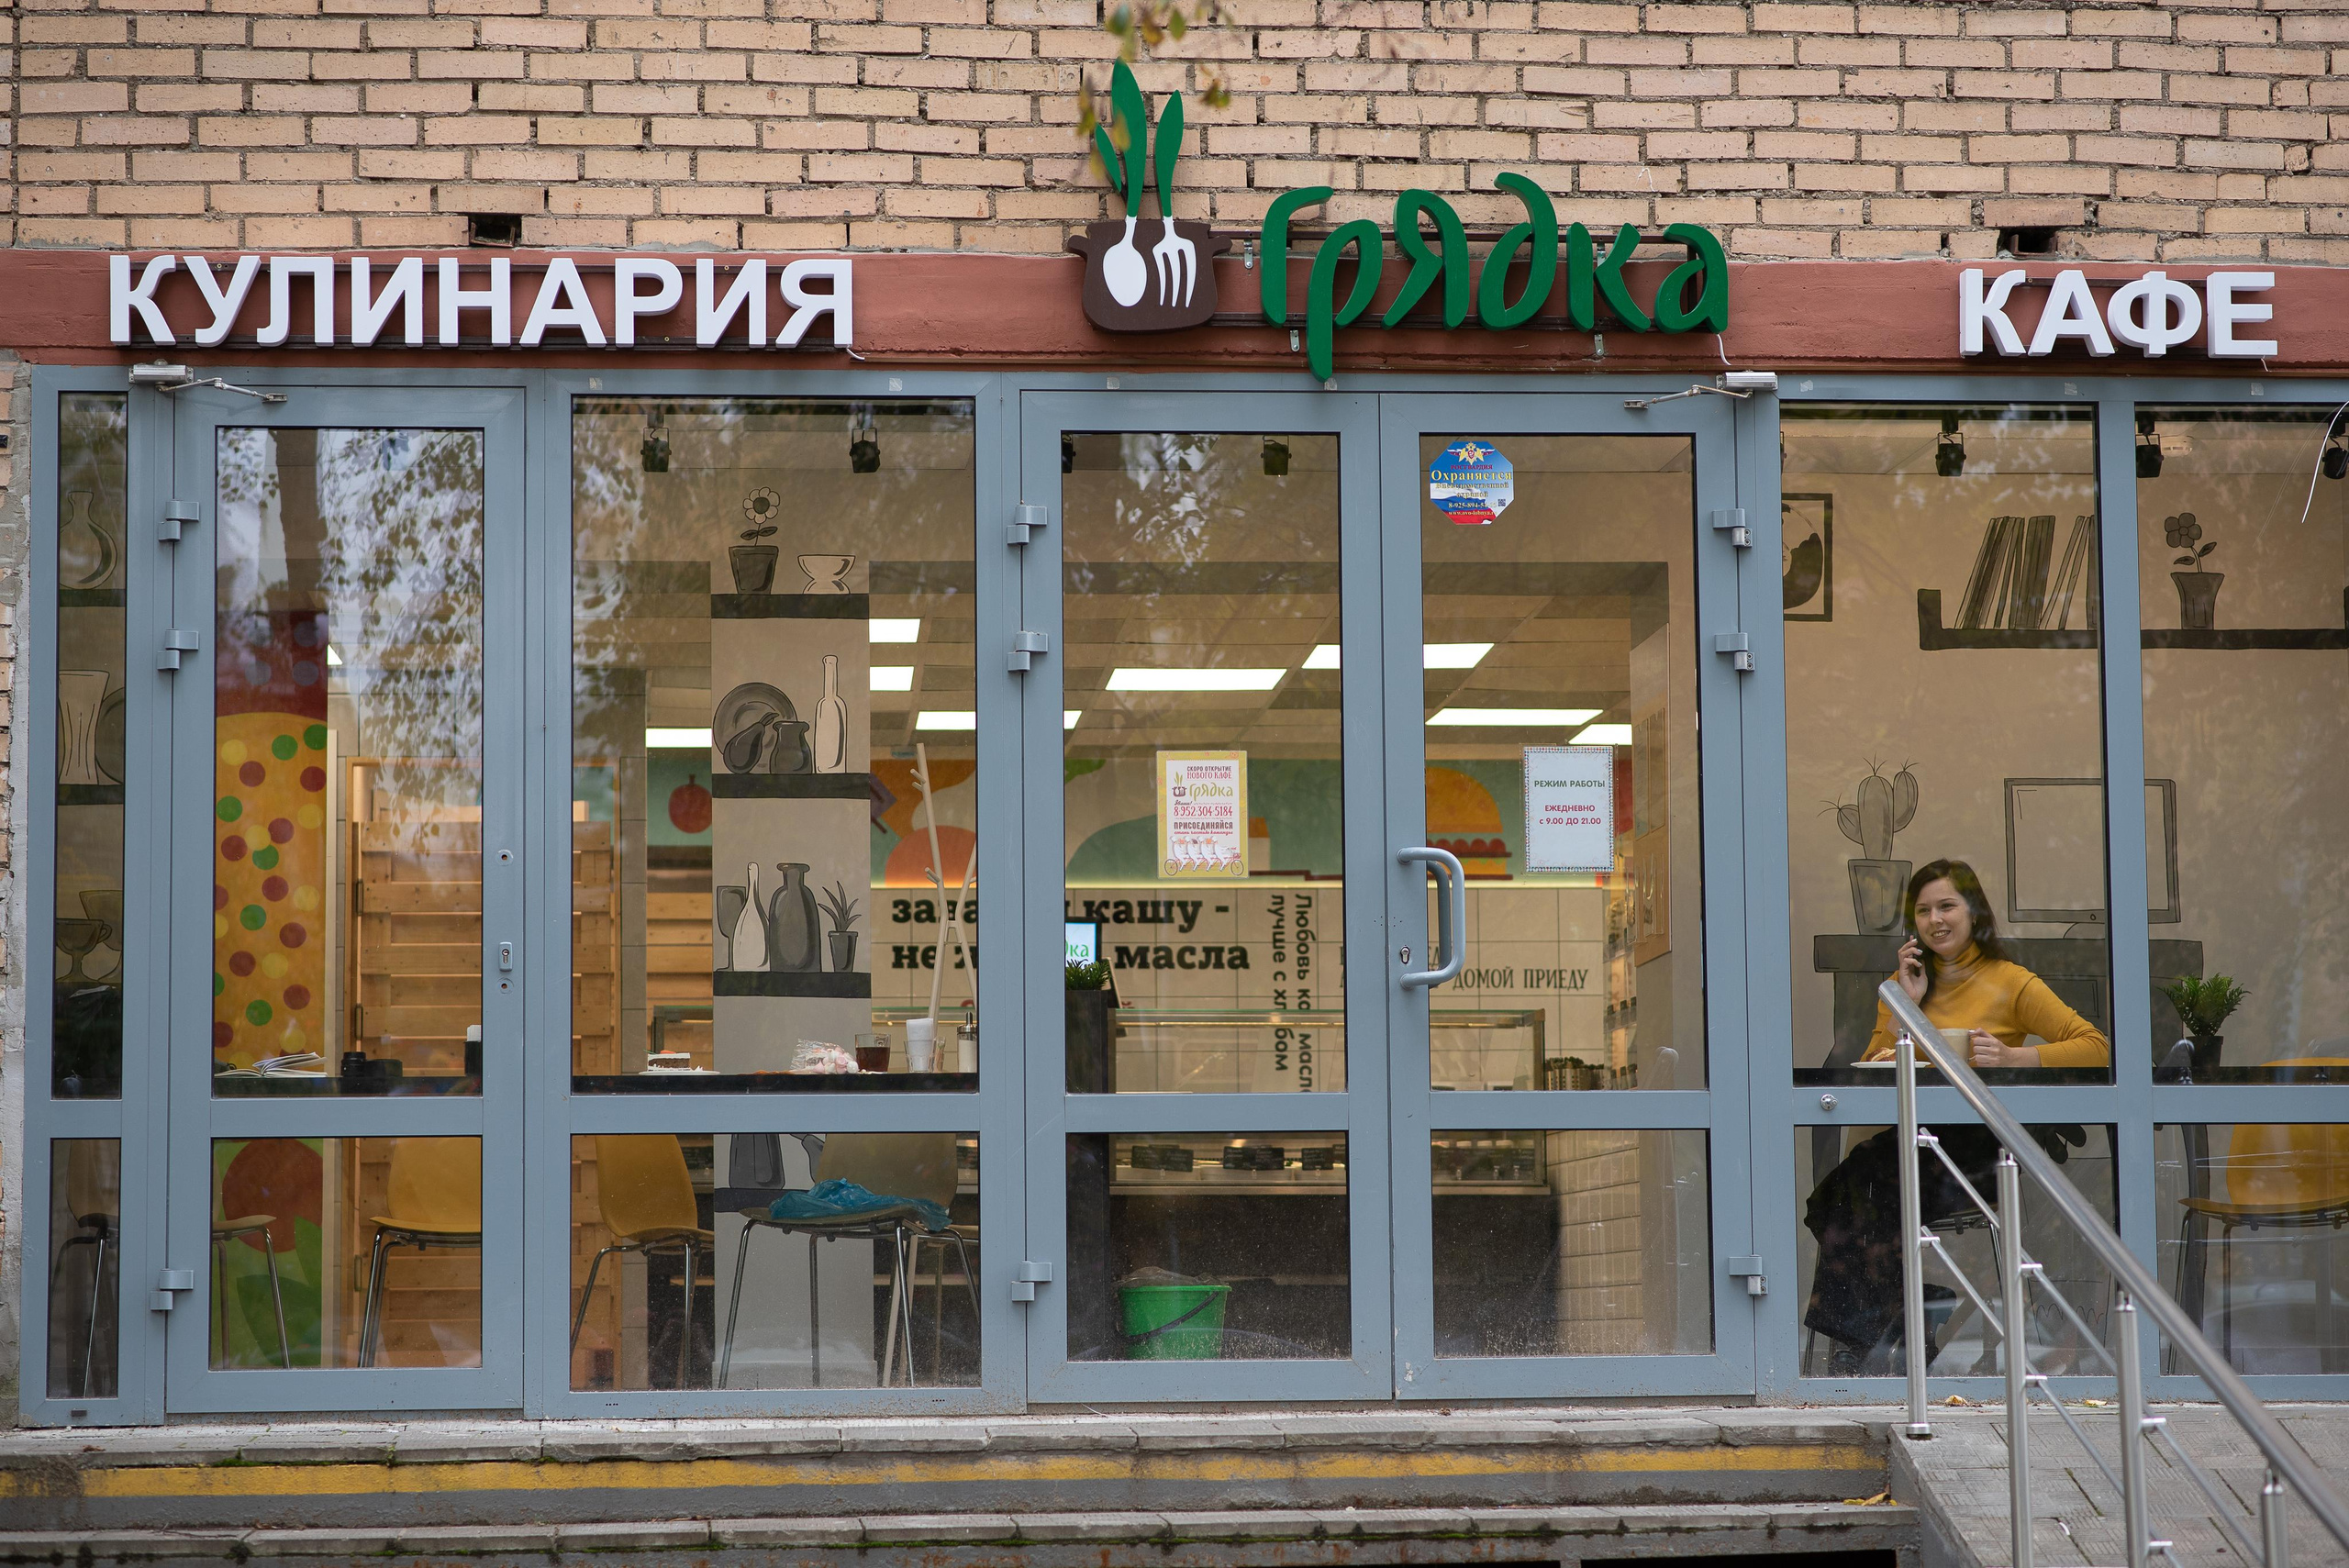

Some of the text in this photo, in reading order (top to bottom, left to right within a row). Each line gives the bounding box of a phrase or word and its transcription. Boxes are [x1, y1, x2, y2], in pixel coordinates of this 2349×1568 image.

[109, 254, 854, 349] КУЛИНАРИЯ
[1959, 268, 2278, 359] КАФЕ
[1431, 470, 1512, 483] Охраняется
[1544, 805, 1596, 813] ЕЖЕДНЕВНО
[1565, 817, 1579, 826] ДО
[1174, 820, 1233, 830] ПРИСОЕДИНЯЙСЯ
[1083, 899, 1203, 933] кашу
[1267, 895, 1286, 963] лучше
[1295, 893, 1316, 981] Любовь
[892, 945, 938, 969] не
[1114, 945, 1251, 970] масла
[1453, 966, 1514, 991] ДОМОЙ
[1523, 968, 1588, 991] ПРИЕДУ
[1274, 988, 1295, 1071] хлбом
